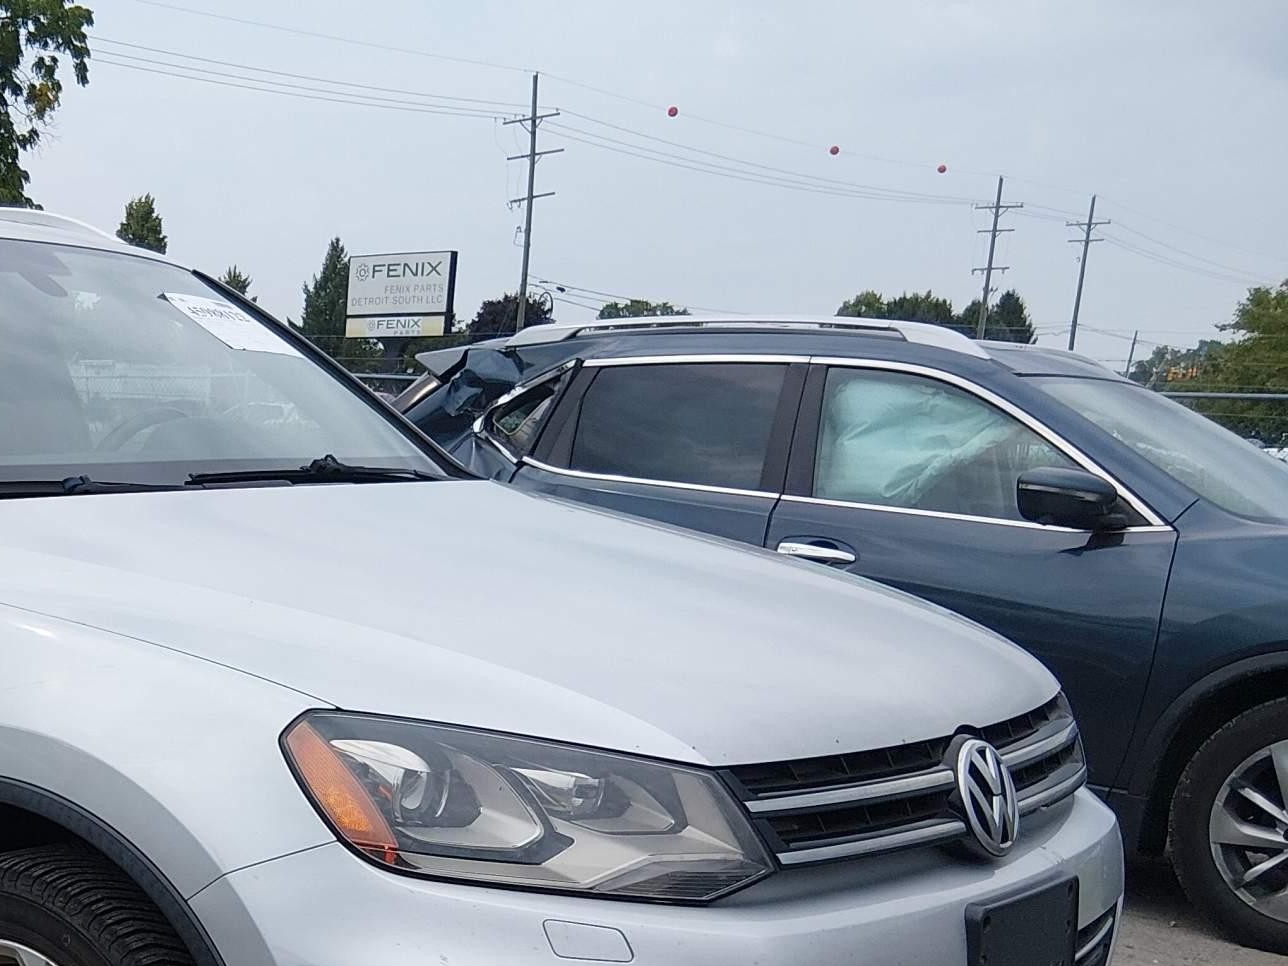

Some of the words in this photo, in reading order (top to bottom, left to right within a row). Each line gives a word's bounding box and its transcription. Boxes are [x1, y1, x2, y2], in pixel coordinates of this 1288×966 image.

[372, 261, 442, 279] FENIX
[384, 285, 410, 294] FENIX
[414, 284, 444, 293] PARTS
[351, 297, 388, 306] DETROIT
[392, 295, 423, 305] SOUTH
[426, 294, 443, 304] LLC
[376, 318, 422, 329] FENIX
